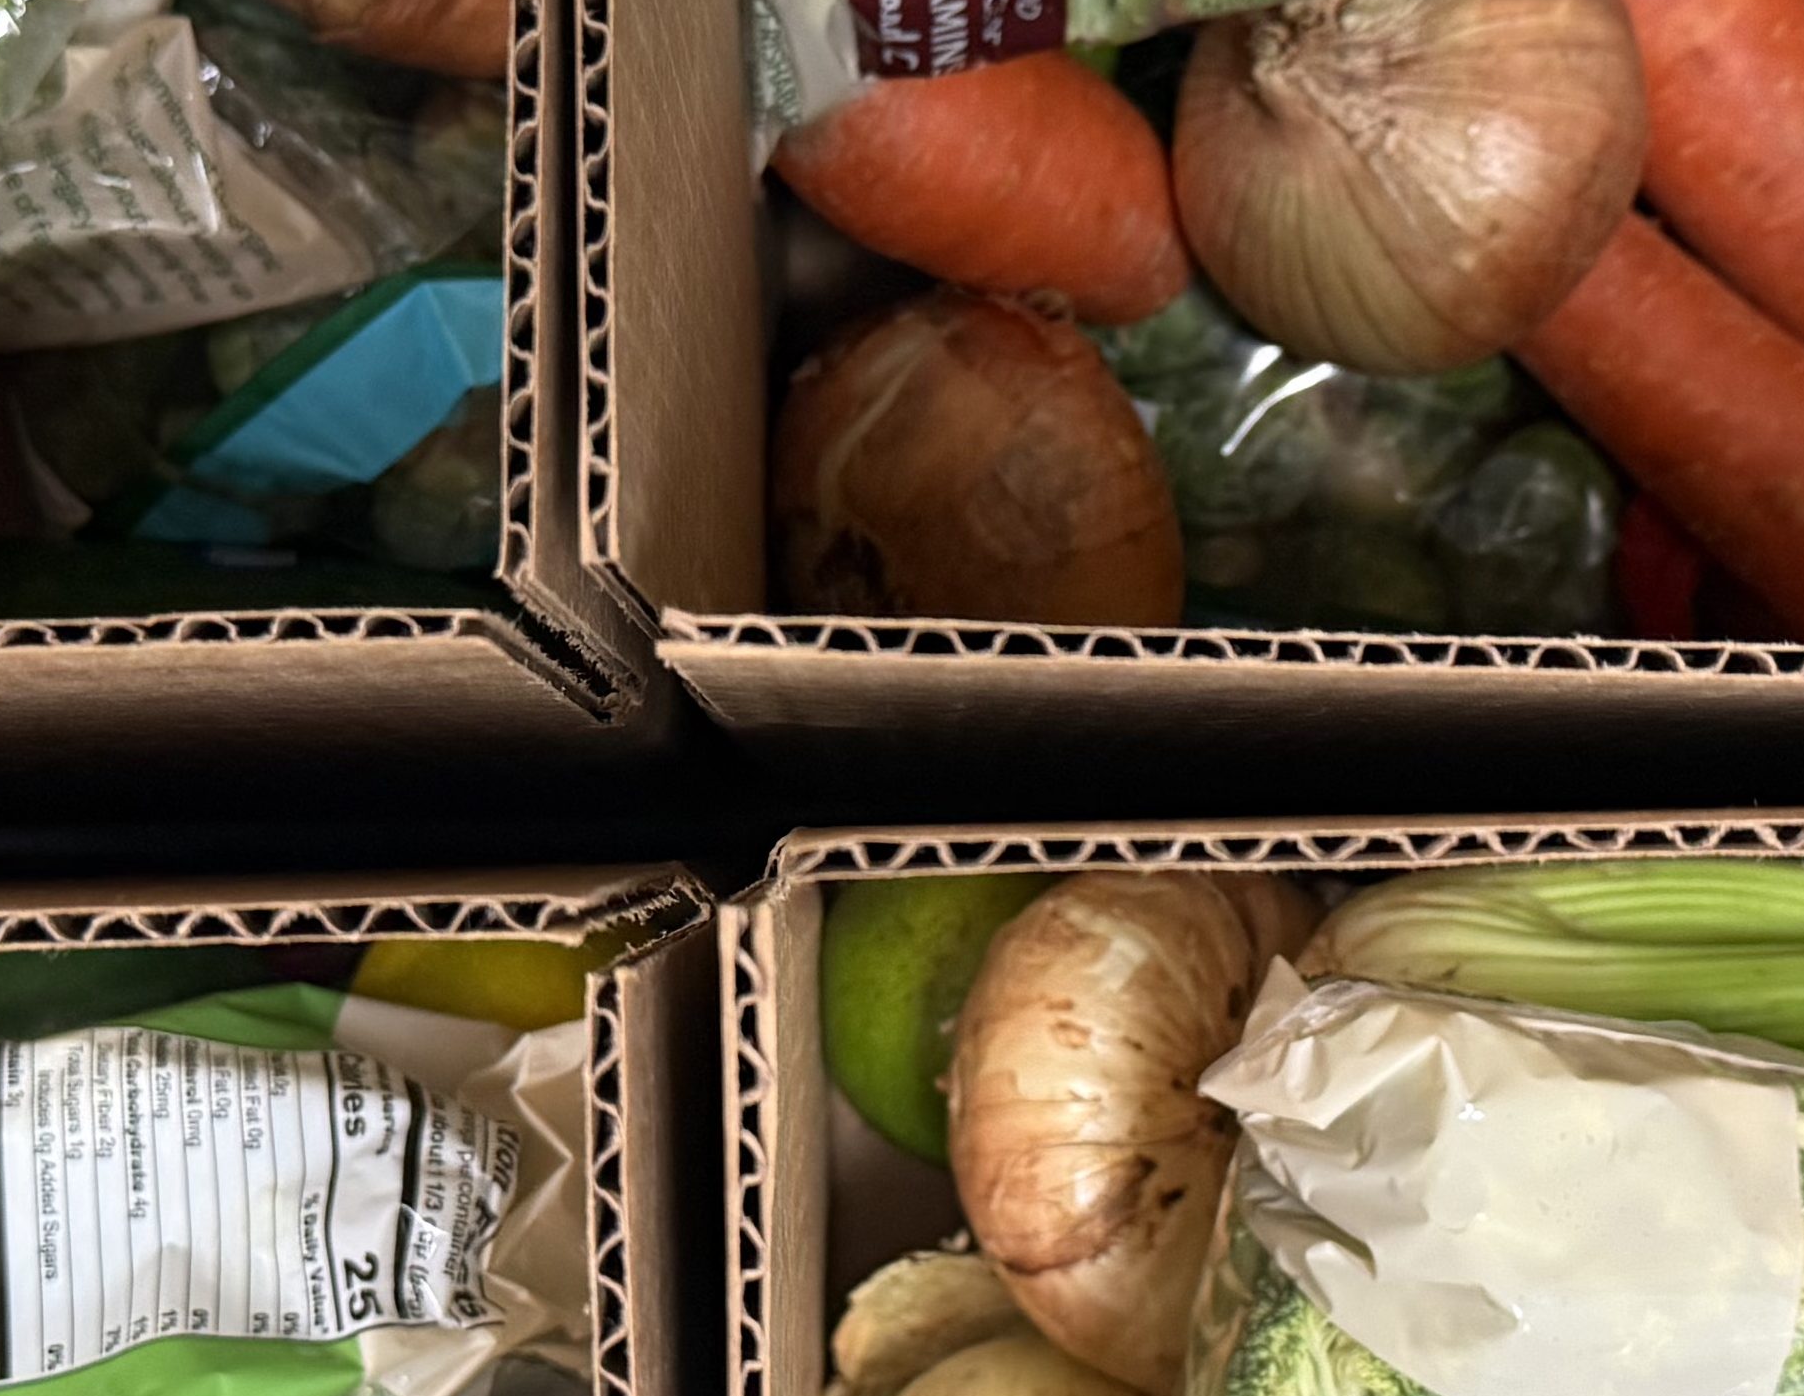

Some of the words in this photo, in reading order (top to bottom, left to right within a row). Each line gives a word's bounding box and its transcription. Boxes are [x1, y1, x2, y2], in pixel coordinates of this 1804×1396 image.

[124, 1059, 145, 1192] Carbohydrate
[41, 1158, 59, 1215] Added
[44, 1220, 60, 1280] Sugars
[443, 1183, 472, 1279] container
[343, 1253, 383, 1322] 25
